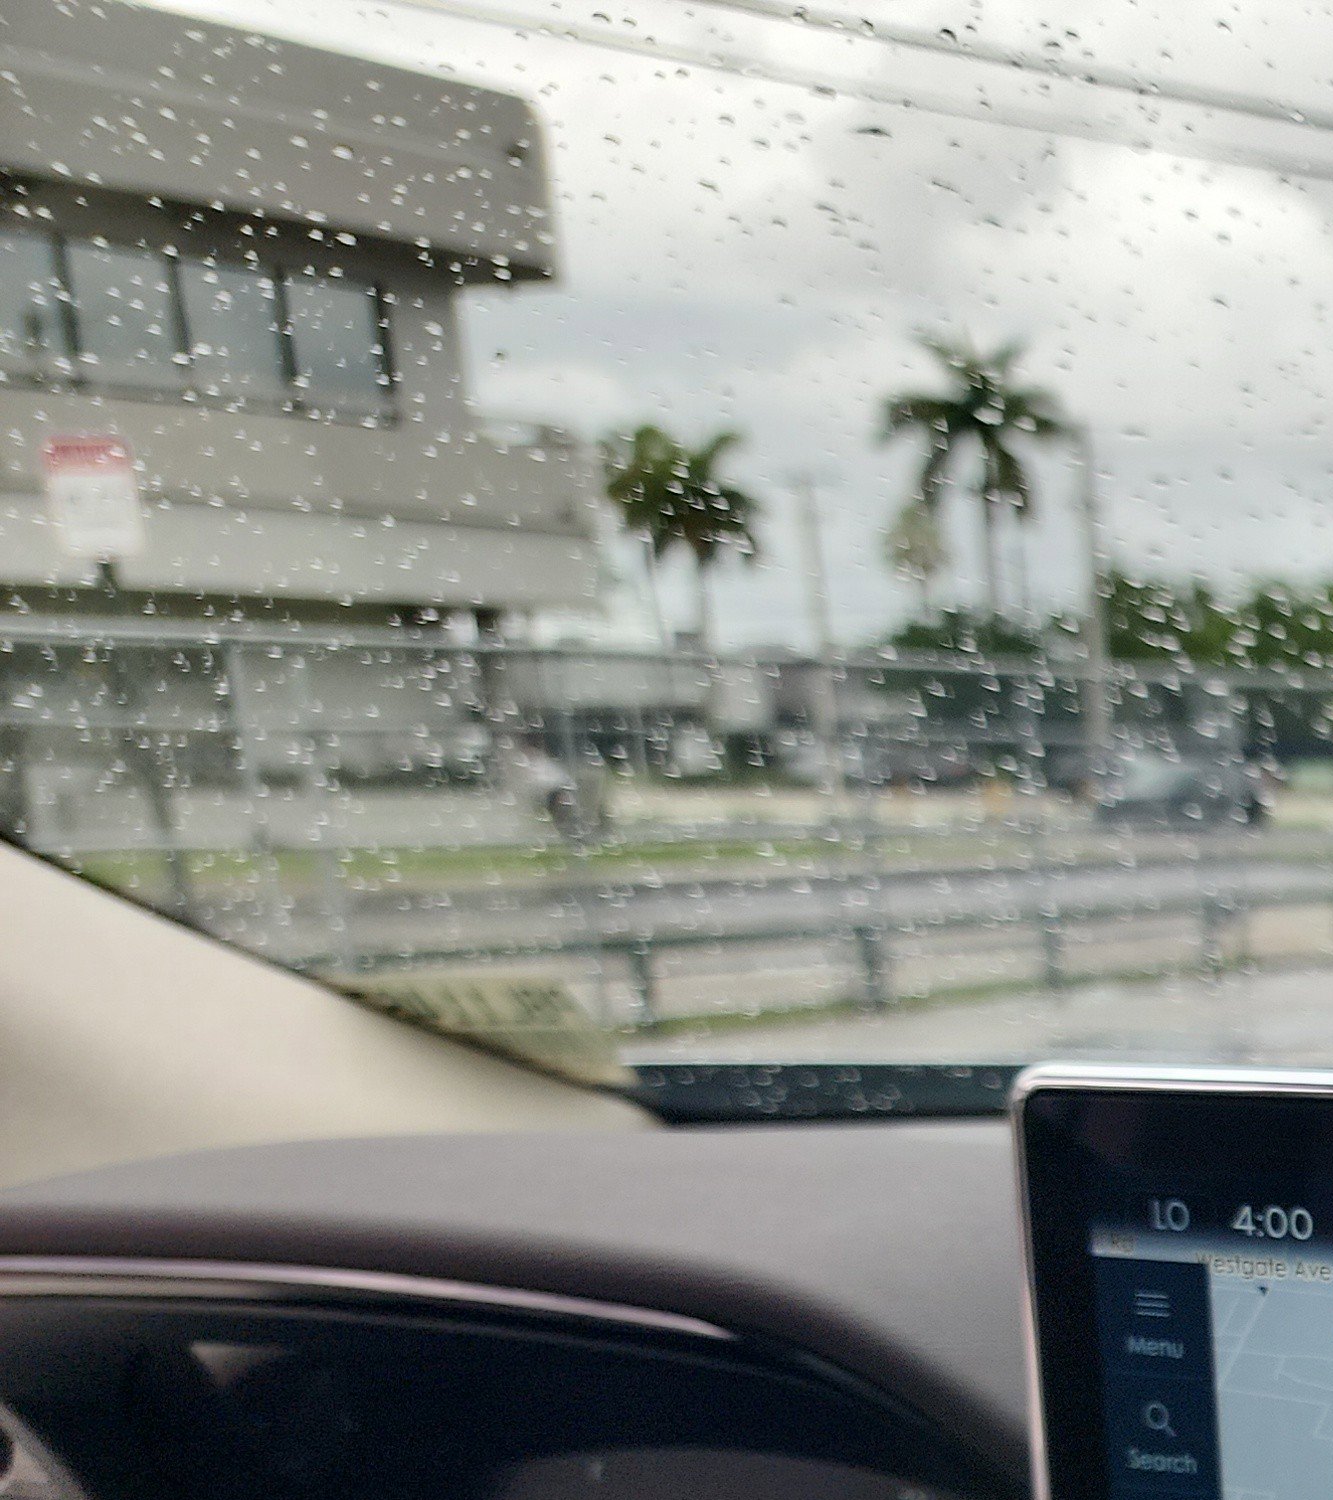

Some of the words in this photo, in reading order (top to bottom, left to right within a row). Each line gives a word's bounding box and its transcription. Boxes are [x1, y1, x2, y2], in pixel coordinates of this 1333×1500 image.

[1149, 1200, 1190, 1232] LO
[1231, 1205, 1314, 1241] 4:00
[1295, 1263, 1332, 1283] Ave
[1129, 1337, 1184, 1360] Menu
[1129, 1449, 1198, 1474] Search
